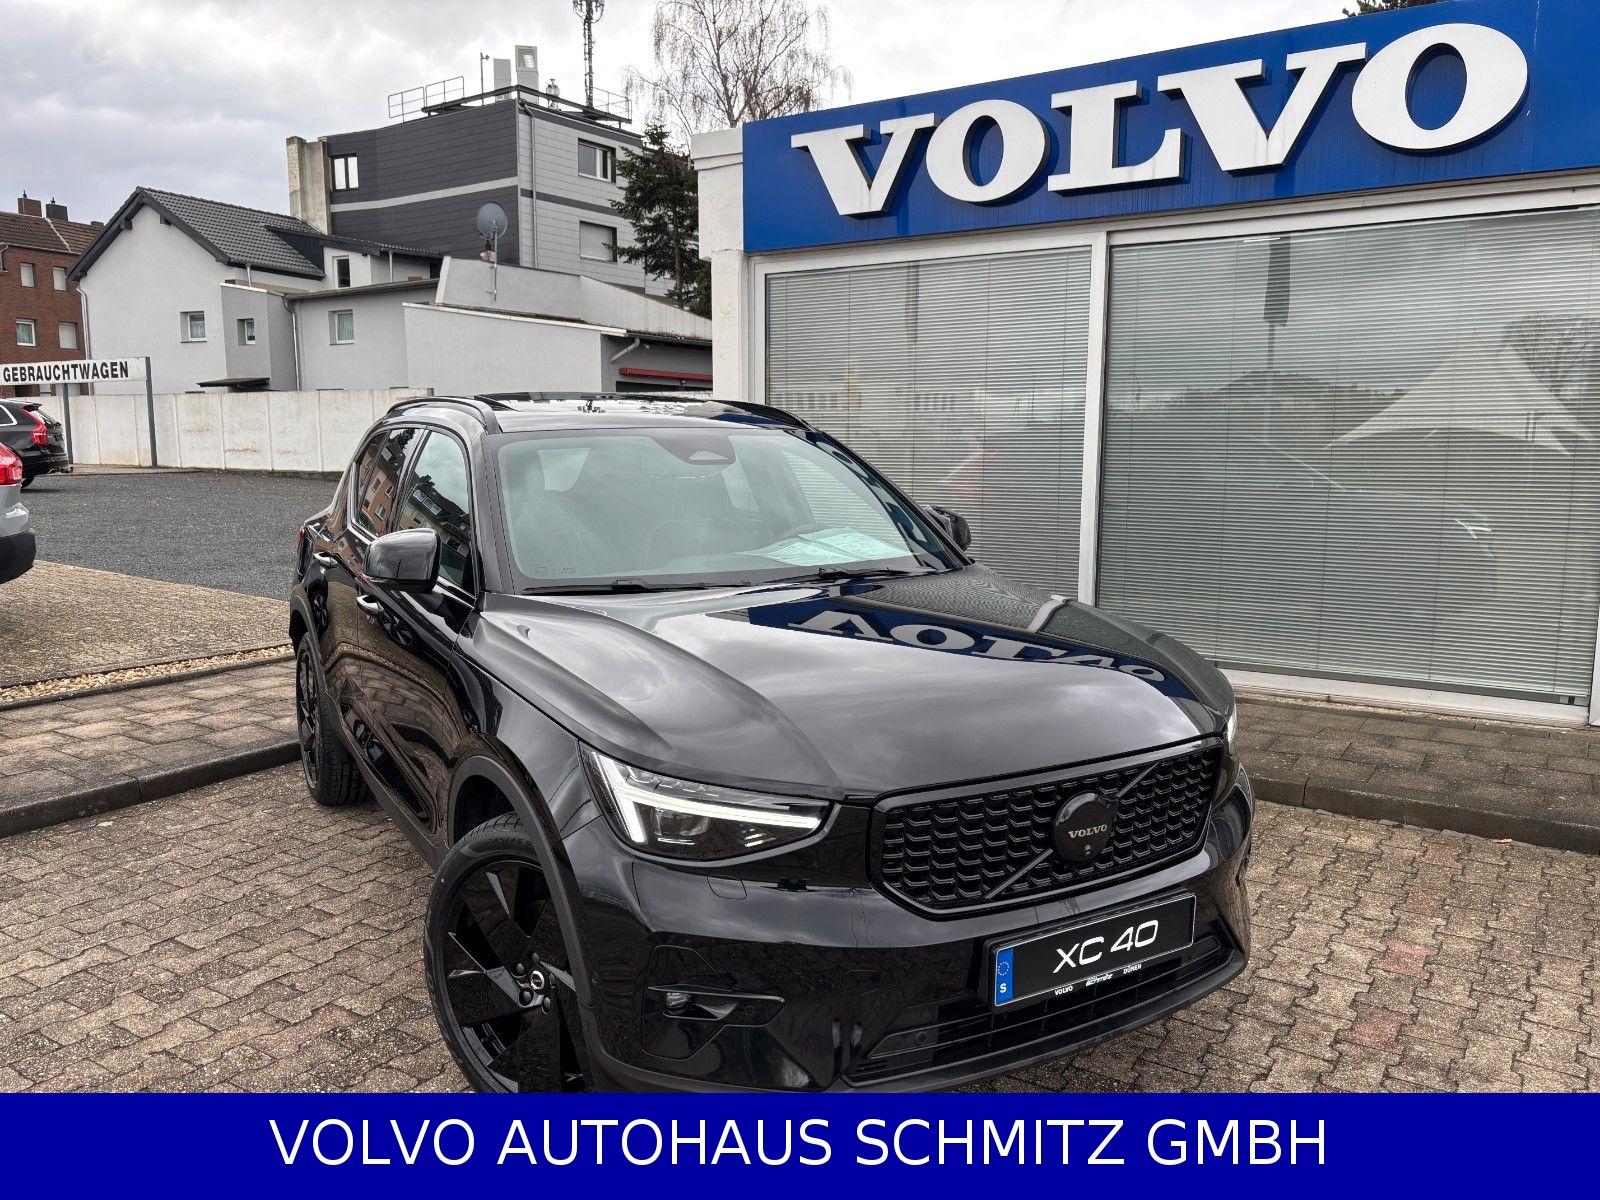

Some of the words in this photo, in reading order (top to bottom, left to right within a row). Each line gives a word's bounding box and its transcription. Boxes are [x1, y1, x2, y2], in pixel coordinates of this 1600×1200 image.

[790, 22, 1528, 217] VOLVO
[3, 361, 129, 383] GEBRAUCHTWAGEN
[1067, 824, 1108, 839] VOLVO
[1053, 936, 1105, 974] XC
[1110, 919, 1159, 952] 40
[999, 982, 1008, 994] S
[1054, 985, 1073, 996] VOLVO
